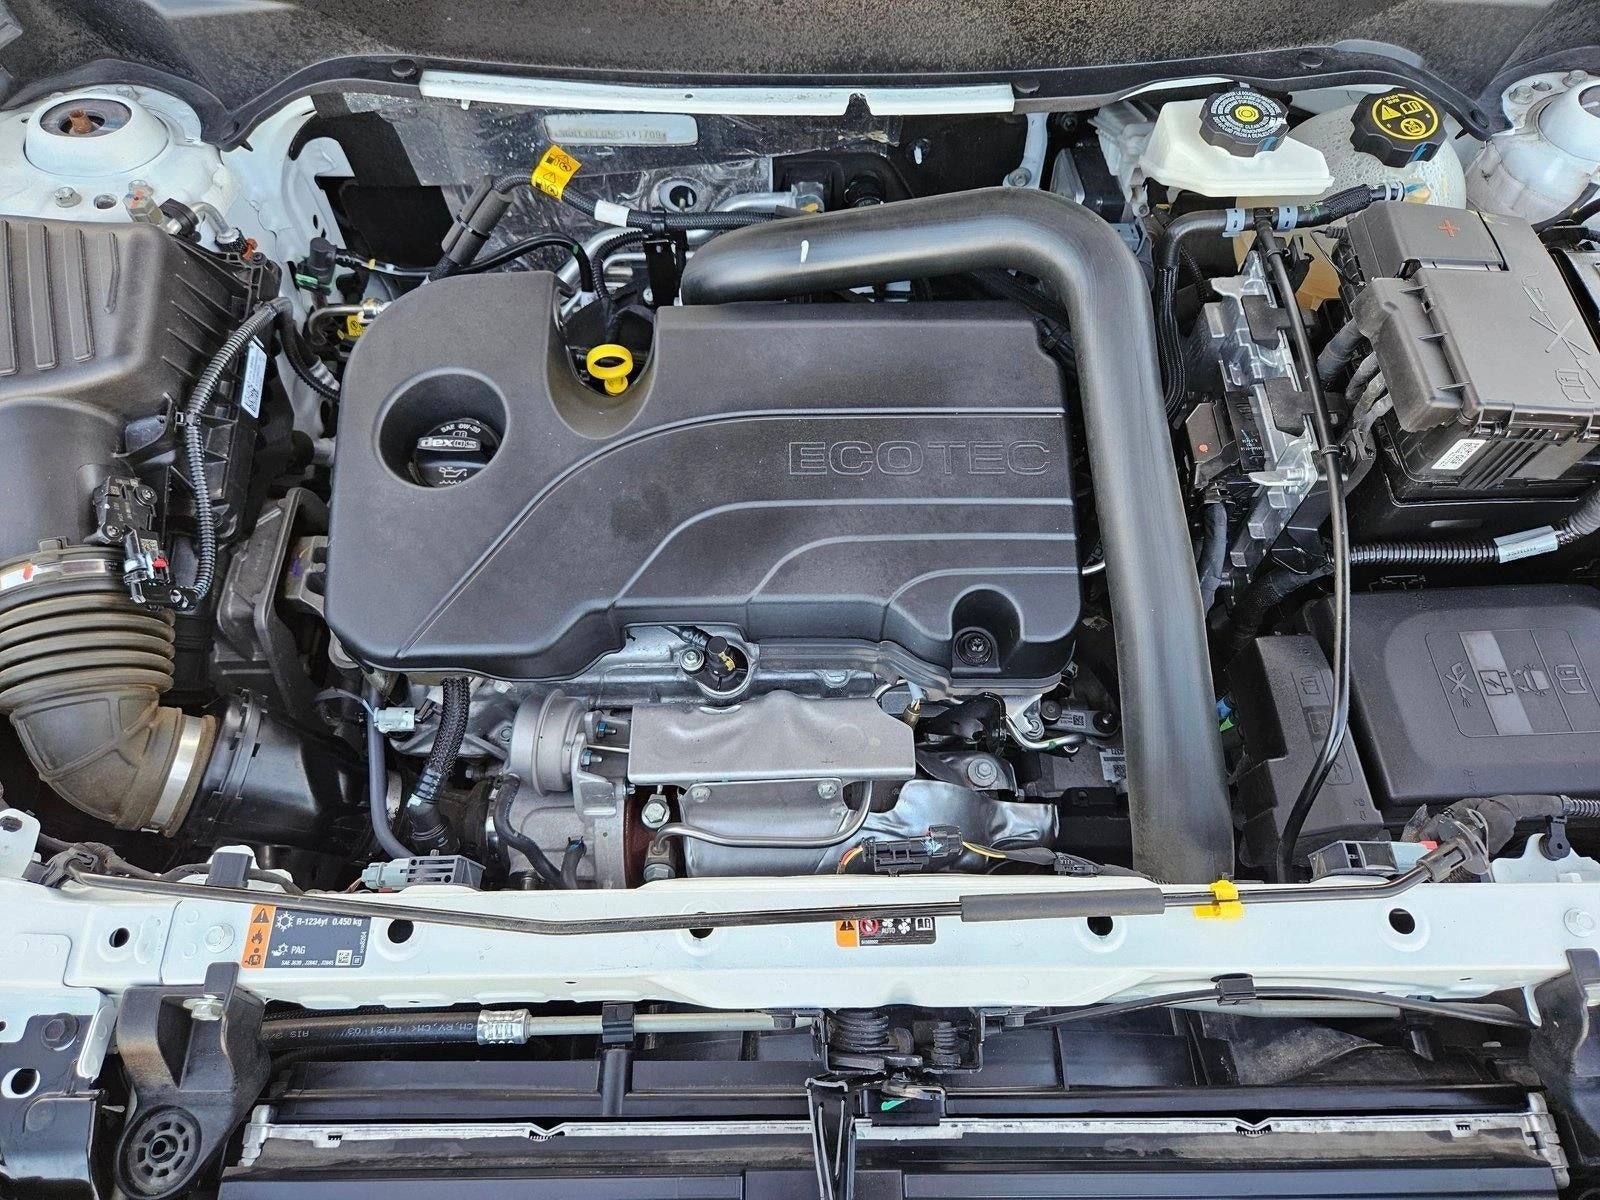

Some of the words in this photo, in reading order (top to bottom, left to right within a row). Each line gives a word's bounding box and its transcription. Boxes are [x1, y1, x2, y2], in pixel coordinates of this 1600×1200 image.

[441, 424, 455, 433] SAE
[458, 423, 481, 434] 0W-20
[420, 437, 477, 449] dexos
[789, 441, 1050, 475] ECOTEC
[296, 917, 328, 927] R-1234yf
[332, 918, 351, 926] 0.450
[353, 918, 362, 927] kg
[291, 946, 306, 954] PAG
